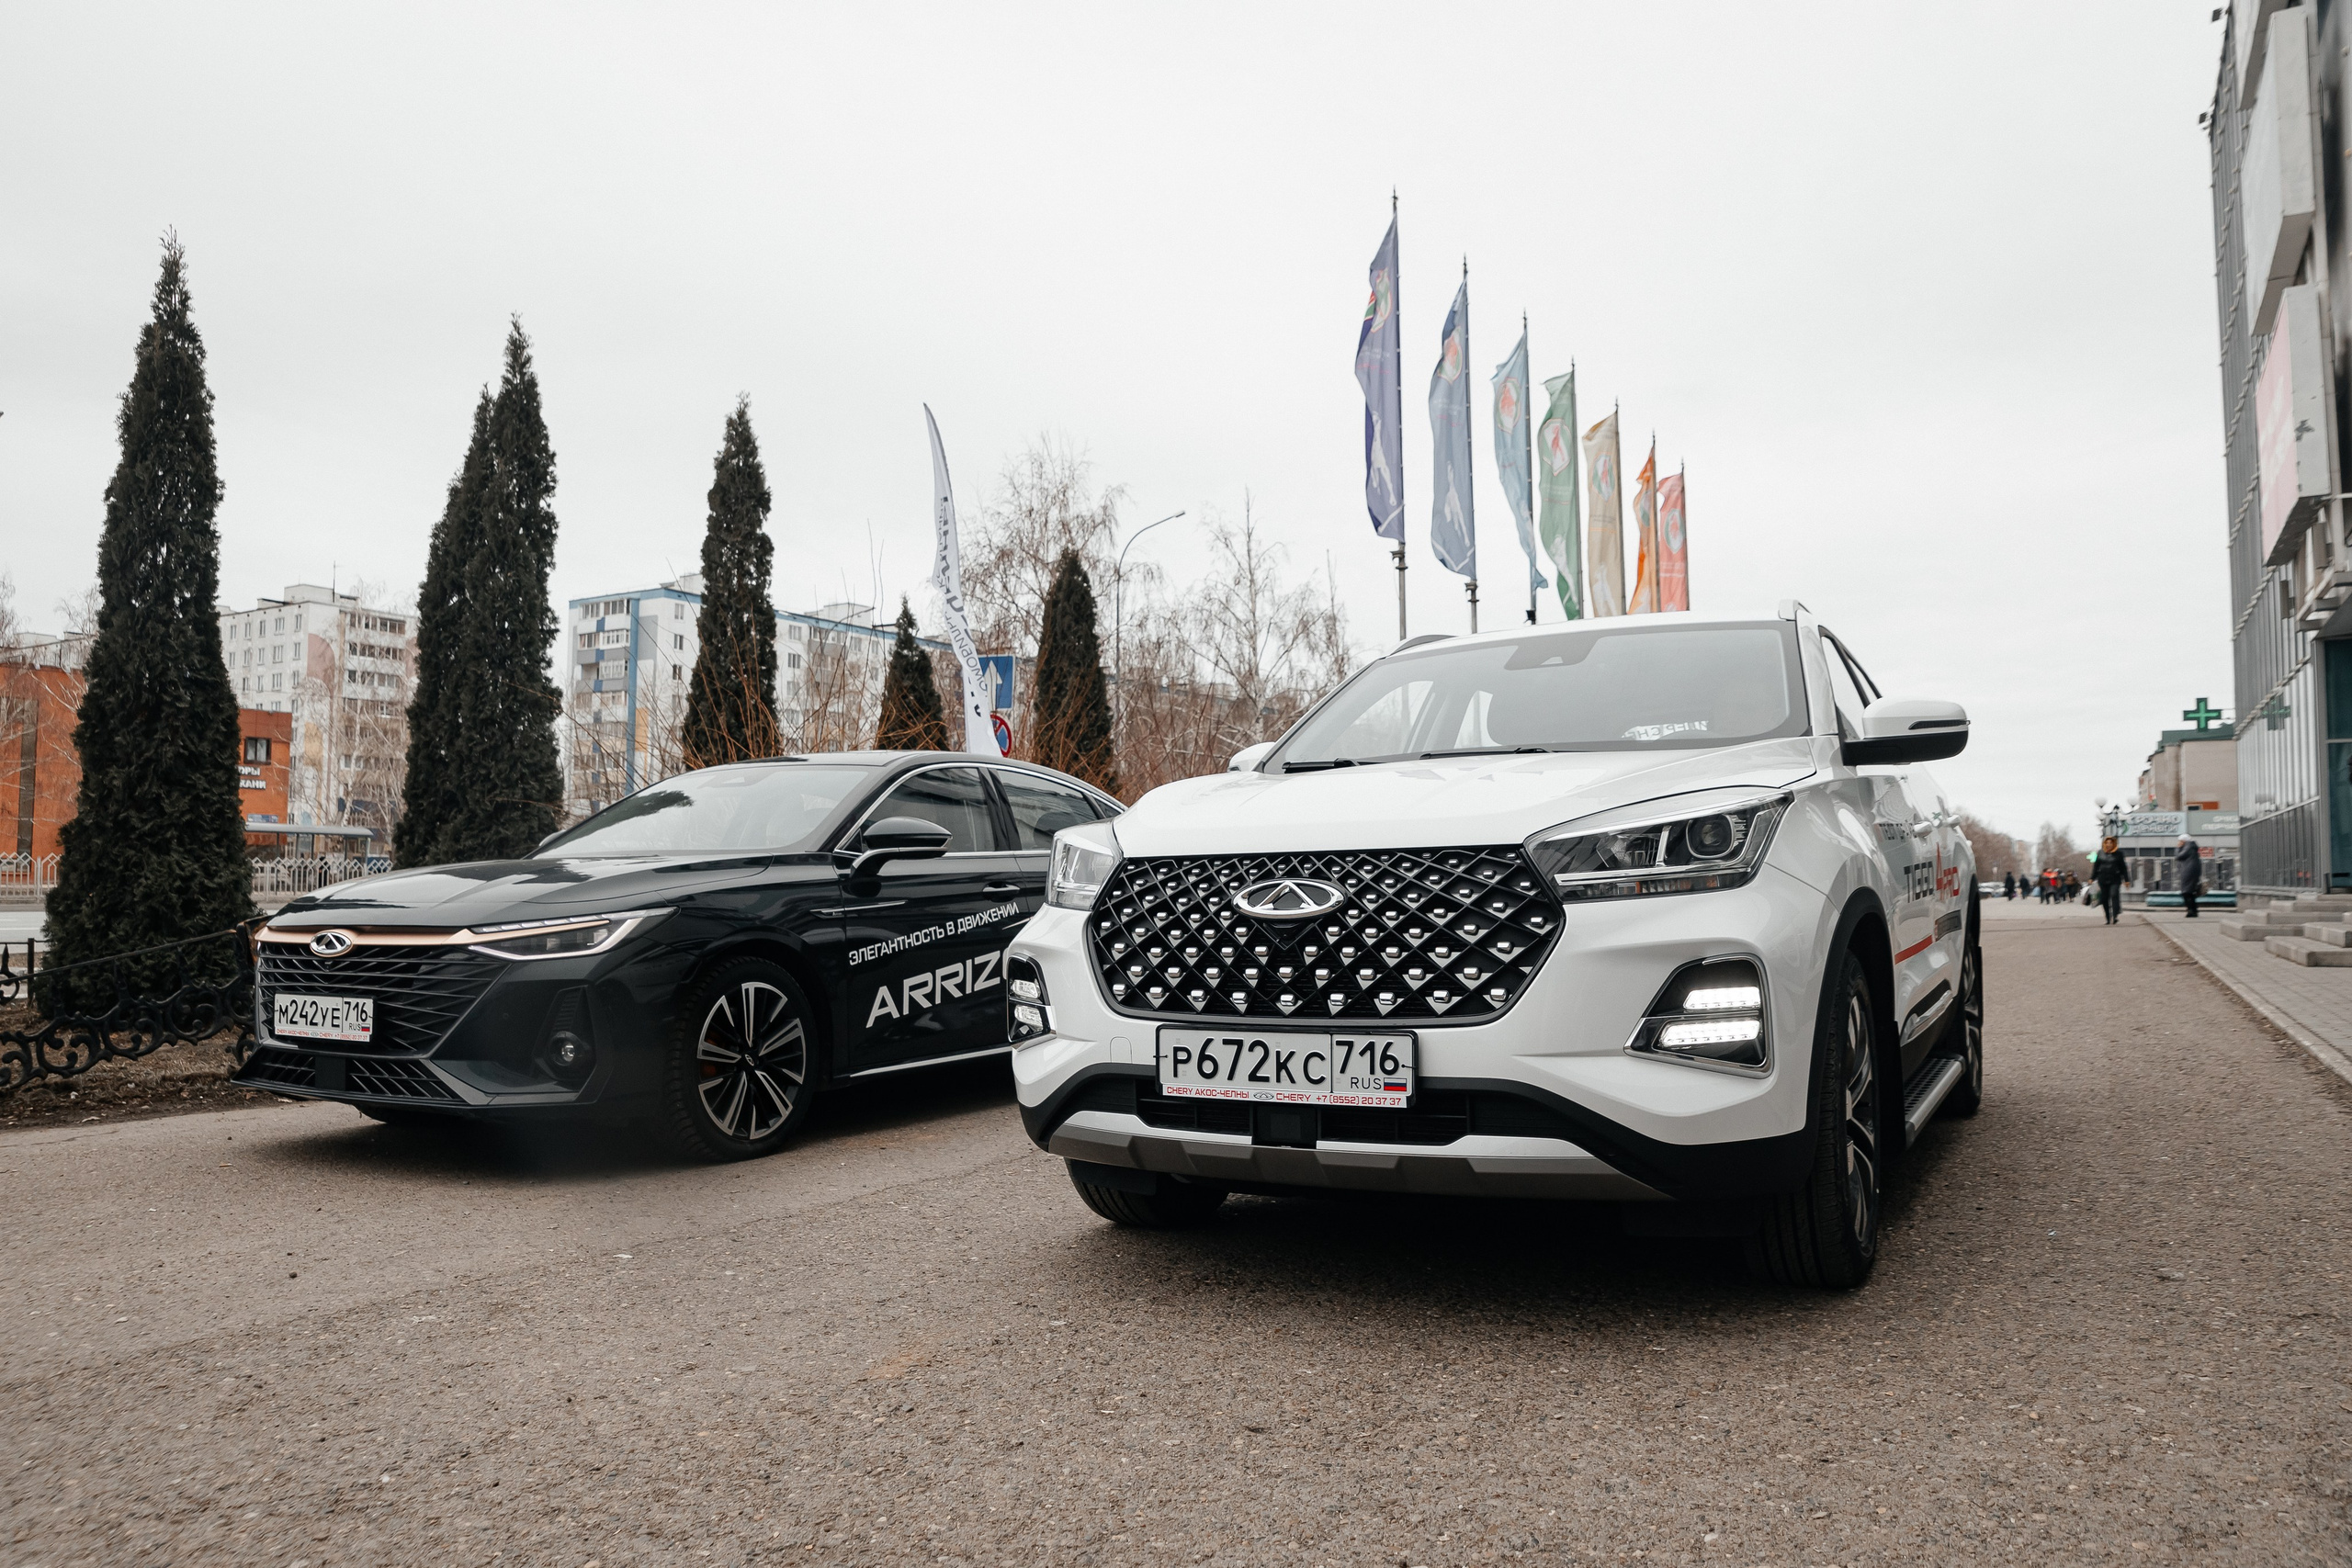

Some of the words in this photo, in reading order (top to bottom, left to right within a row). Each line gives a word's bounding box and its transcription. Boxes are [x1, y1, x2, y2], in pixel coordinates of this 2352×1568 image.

[237, 766, 261, 776] ОРЫ
[240, 779, 266, 789] КАНИ
[848, 925, 945, 966] ЭЛЕГАНТНОСТЬ
[945, 921, 956, 936] В
[956, 902, 1020, 935] ДВИЖЕНИИ
[278, 998, 340, 1028] М242УЕ
[344, 1000, 368, 1022] 716
[348, 1022, 361, 1031] RUS
[1173, 1037, 1326, 1085] Р672КС
[1335, 1040, 1400, 1076] 716
[1351, 1077, 1382, 1090] RUS
[1166, 1086, 1193, 1095] CHERY
[1194, 1088, 1250, 1099] АКОС-ЧЕЛНЫ
[1275, 1093, 1312, 1102] CHERY
[1316, 1095, 1328, 1103] +7
[1329, 1094, 1360, 1105] (8552)
[1362, 1097, 1374, 1105] 20
[1375, 1097, 1387, 1105] 37
[1389, 1098, 1402, 1106] 37
